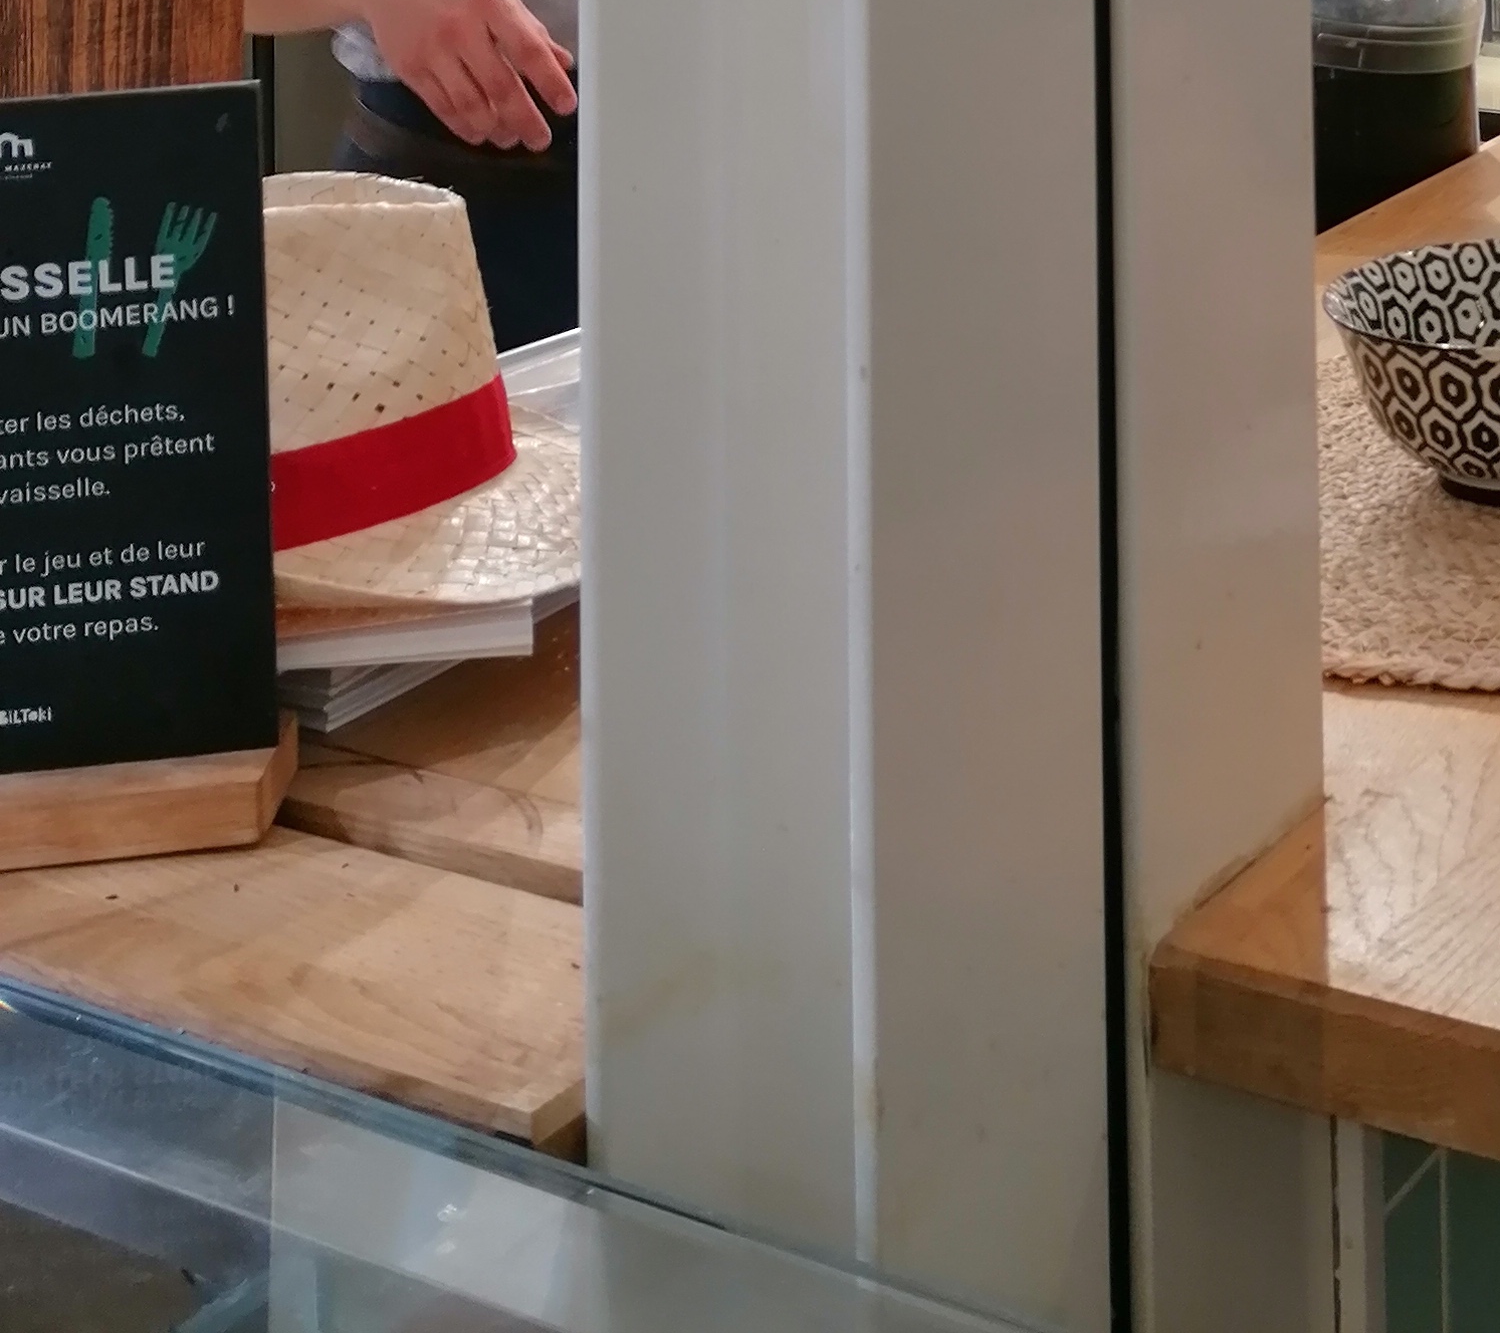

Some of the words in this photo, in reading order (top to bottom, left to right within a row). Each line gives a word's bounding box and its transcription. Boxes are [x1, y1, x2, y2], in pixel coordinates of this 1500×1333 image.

[41, 296, 219, 335] BOOMERANG
[37, 411, 71, 431] les
[79, 402, 186, 428] déchets,
[56, 443, 116, 465] vous
[124, 432, 216, 464] prêtent
[15, 554, 36, 574] le
[40, 549, 81, 578] jeu
[88, 546, 114, 565] et
[120, 543, 150, 565] de
[157, 539, 206, 561] leur
[53, 579, 122, 606] LEUR
[129, 570, 219, 599] STAND
[13, 621, 77, 645] votre
[84, 614, 160, 641] repas.
